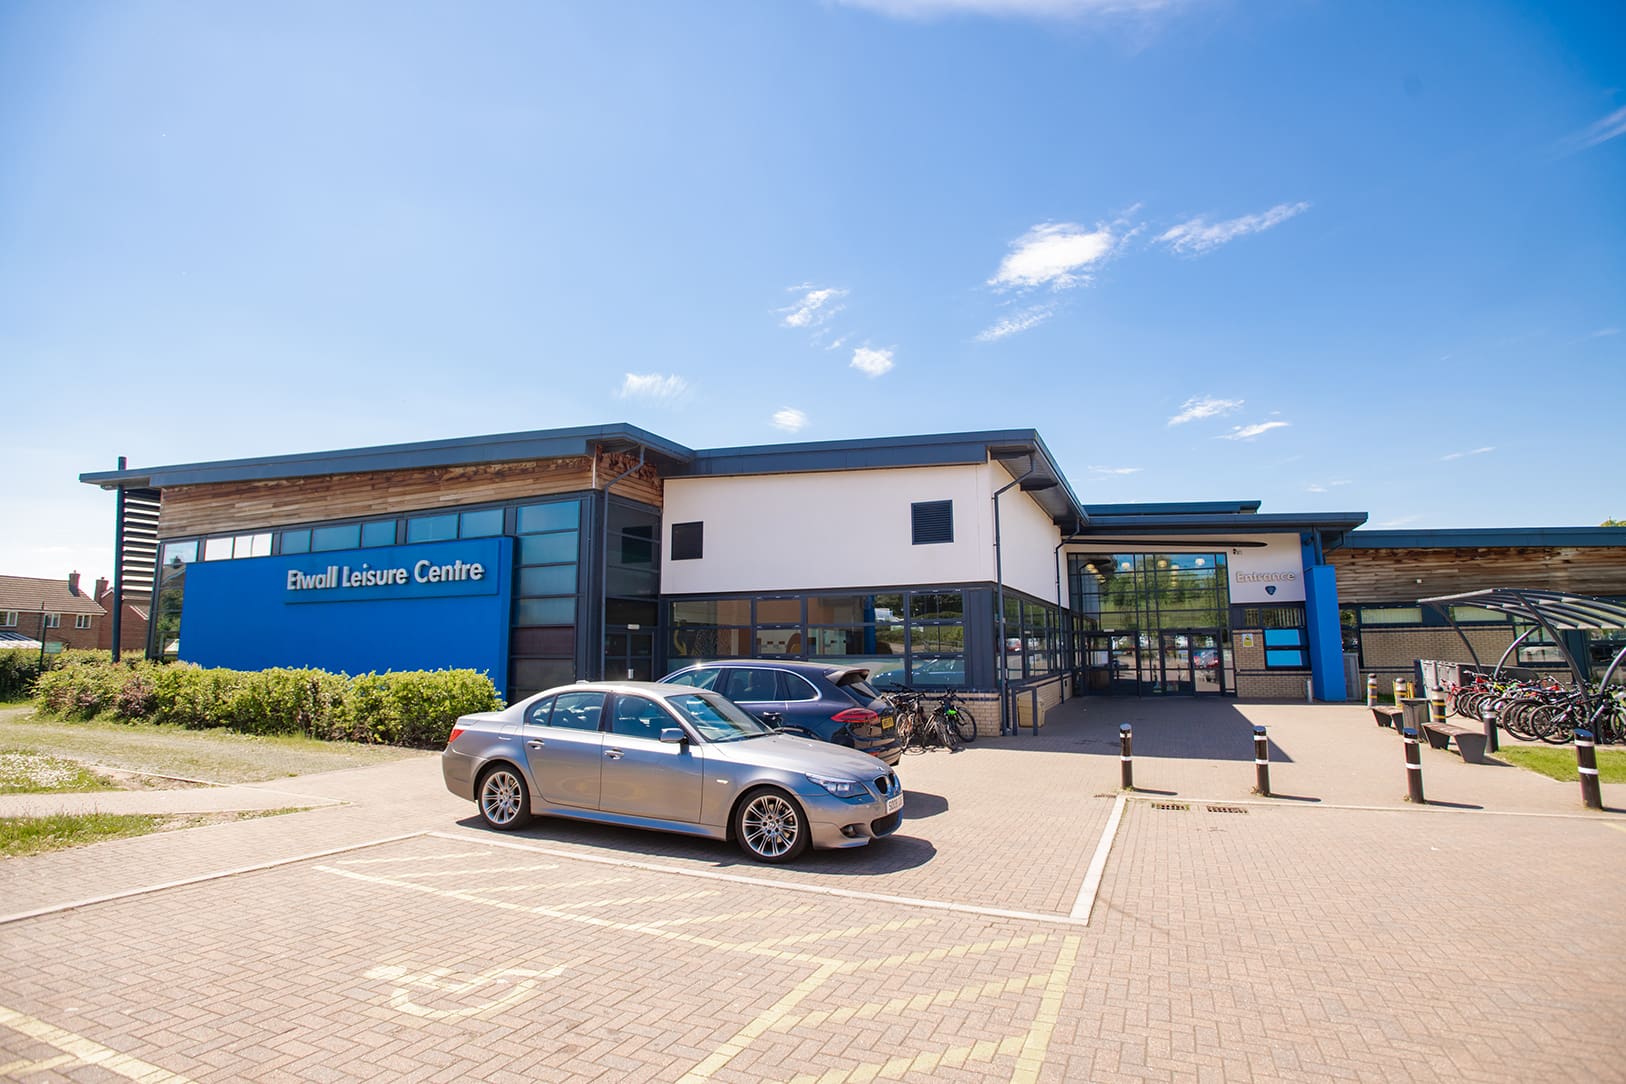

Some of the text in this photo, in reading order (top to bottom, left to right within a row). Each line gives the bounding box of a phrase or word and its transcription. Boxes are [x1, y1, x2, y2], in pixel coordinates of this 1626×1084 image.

[286, 559, 485, 591] Etwall Leisure Centre
[1236, 571, 1296, 583] Entrance
